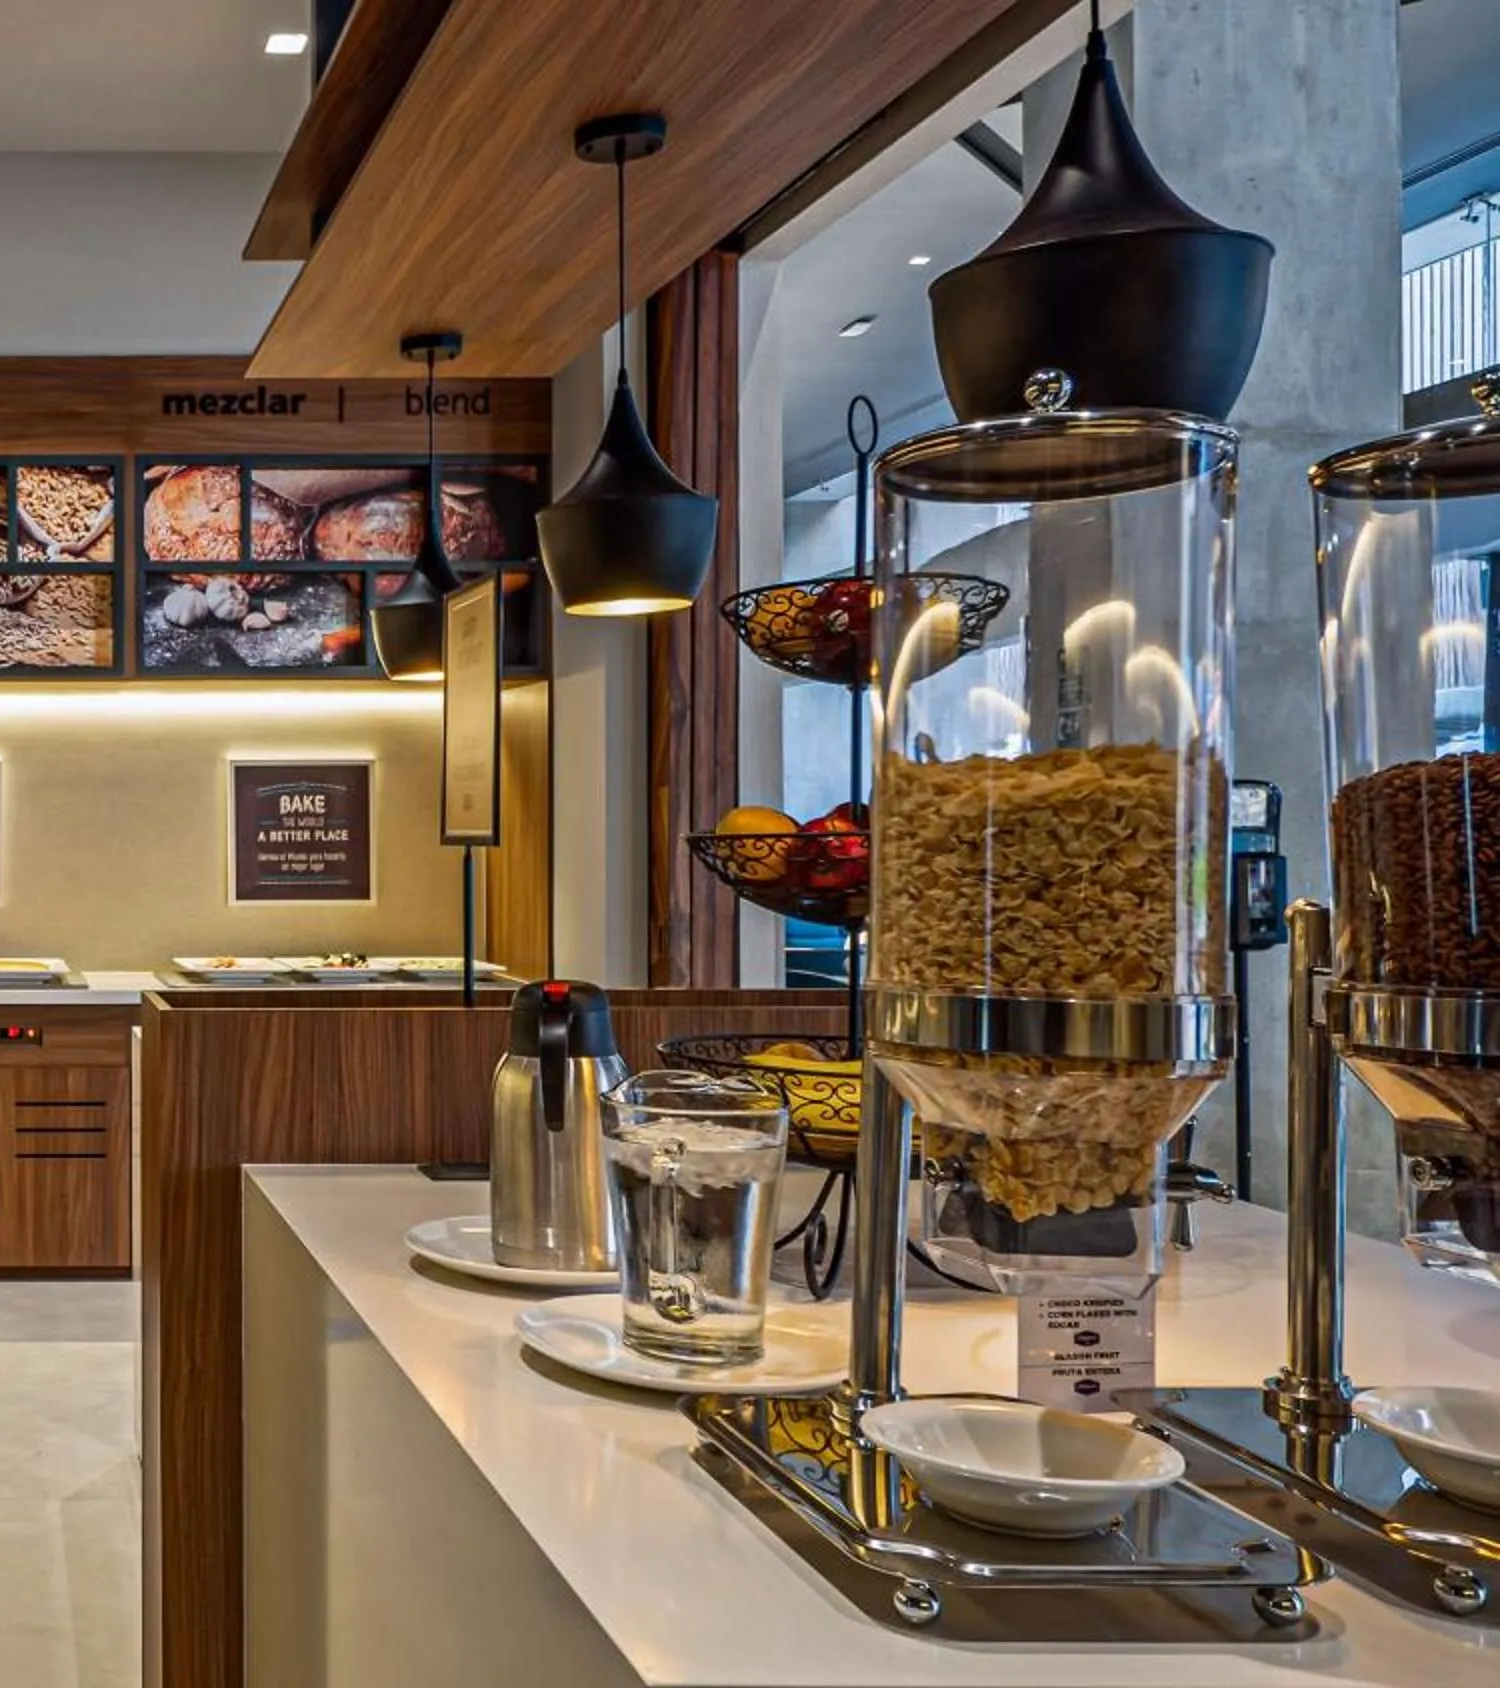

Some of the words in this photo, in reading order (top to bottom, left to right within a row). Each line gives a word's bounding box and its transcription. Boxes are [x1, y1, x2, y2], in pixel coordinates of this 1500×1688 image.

[162, 386, 306, 415] mezclar
[405, 385, 490, 416] blend
[279, 794, 326, 815] BAKE
[257, 831, 266, 842] A
[269, 830, 311, 842] BETTER
[315, 829, 349, 841] PLACE
[1047, 1311, 1074, 1319] CORN
[1075, 1310, 1111, 1318] FLAKES
[1052, 1367, 1082, 1377] FRUTA
